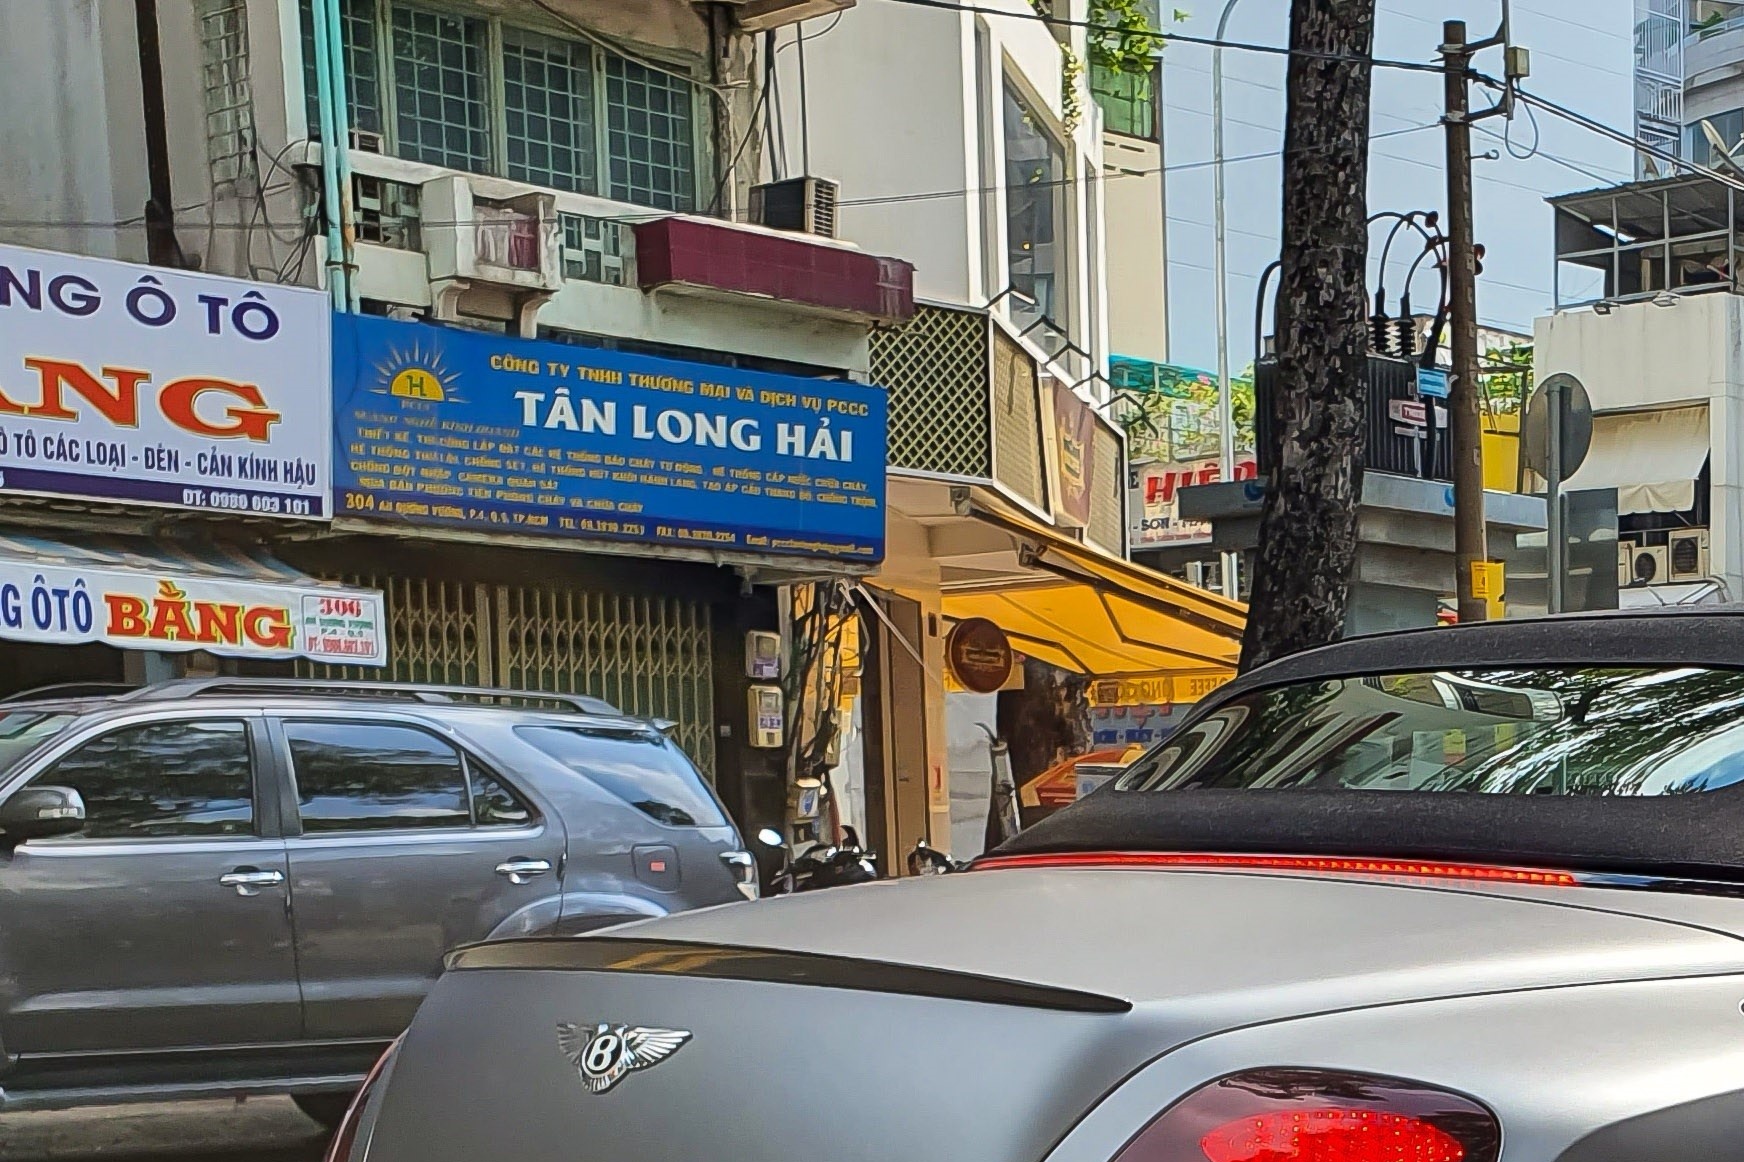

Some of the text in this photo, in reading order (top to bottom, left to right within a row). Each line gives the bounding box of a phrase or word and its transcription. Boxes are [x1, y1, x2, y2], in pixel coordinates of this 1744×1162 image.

[125, 275, 177, 327] Ô
[198, 291, 280, 340] TÔ
[490, 353, 540, 376] CÔNG
[546, 362, 571, 379] TY
[576, 366, 623, 386] TNHH
[628, 372, 695, 395] THƯƠNG
[699, 382, 731, 401] MẠI
[827, 400, 869, 418] PCCC
[13, 428, 37, 459] TÔ
[42, 431, 81, 463] CÁC
[85, 440, 127, 473] LOẠI
[513, 386, 617, 436] TÂN
[631, 404, 763, 451] LONG
[775, 416, 854, 463] HẢI
[345, 492, 375, 511] 304
[31, 573, 93, 634] ÔTÔ
[103, 579, 297, 650] BẰNG
